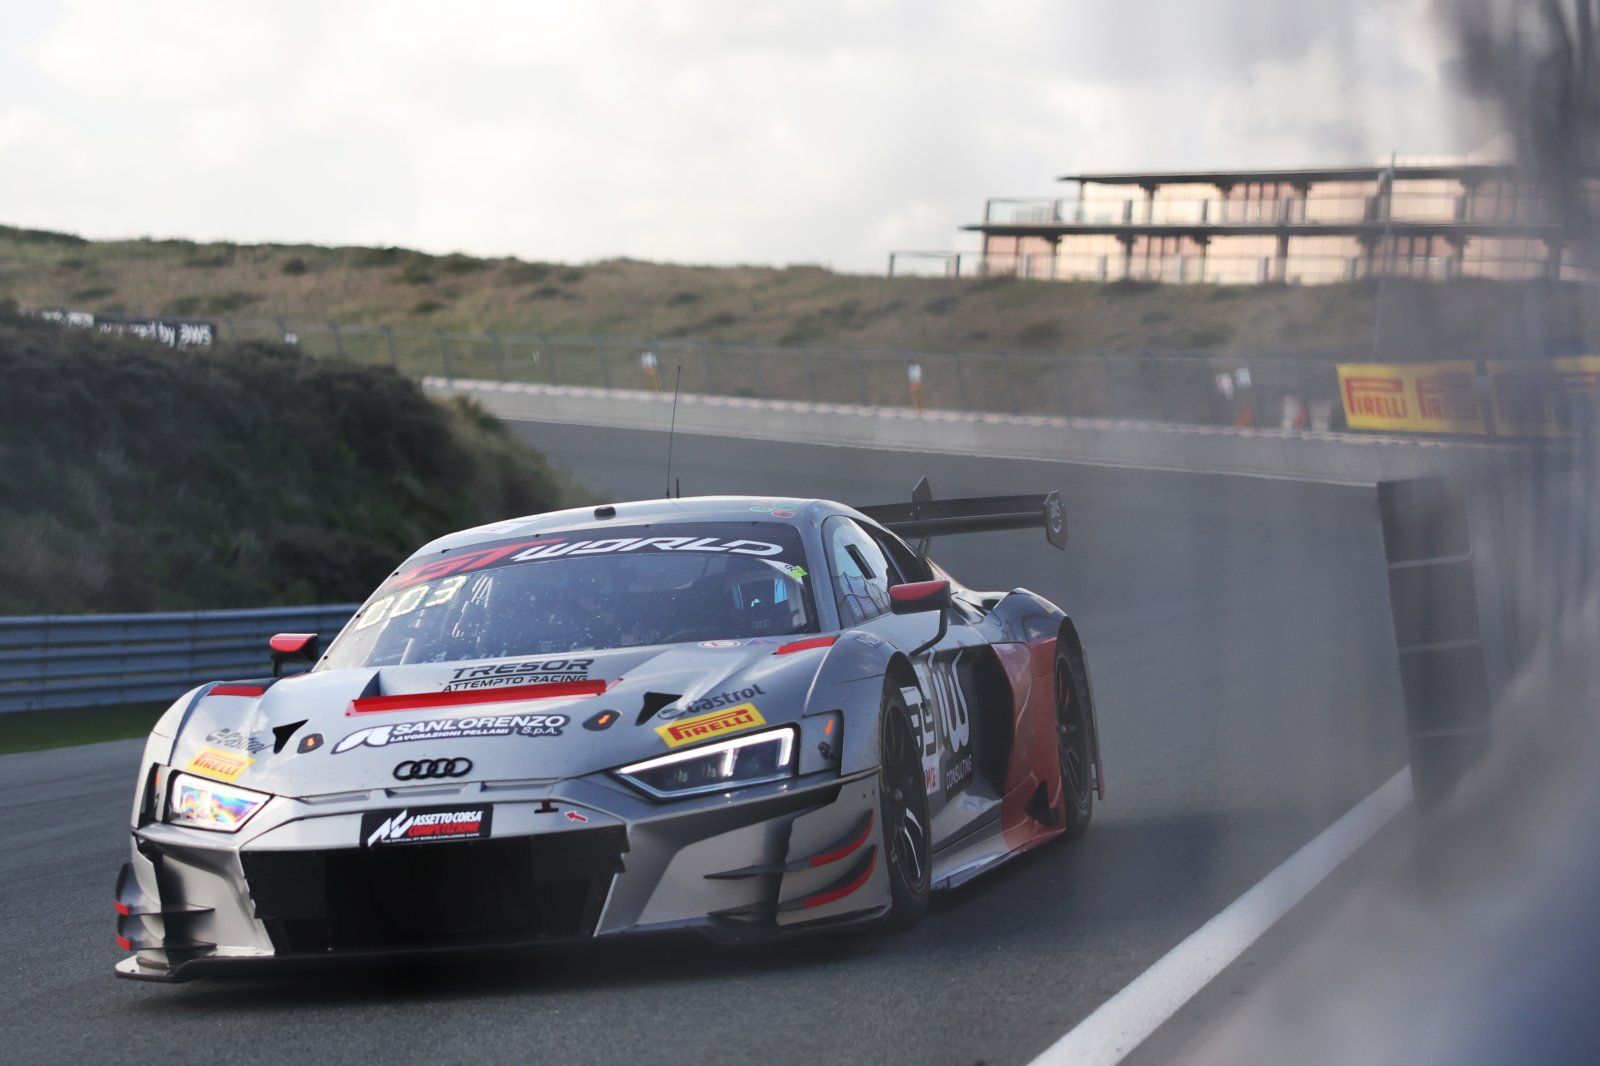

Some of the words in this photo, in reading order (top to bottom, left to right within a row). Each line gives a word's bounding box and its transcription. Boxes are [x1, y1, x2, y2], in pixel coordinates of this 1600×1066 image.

[1344, 377, 1408, 419] PIRELLI
[510, 537, 784, 562] WORLD
[453, 658, 595, 680] TRESOR
[442, 676, 524, 693] ATTEMPTO
[528, 674, 588, 684] RACING
[687, 683, 766, 714] Castrol
[390, 731, 461, 742] LAVORAZIONI
[463, 728, 509, 737] PELLAMI
[521, 726, 557, 736] S.p.A.
[394, 715, 565, 735] SANLORENZO
[667, 708, 755, 741] PIRELLI
[193, 752, 245, 776] PIRELLI
[413, 812, 454, 826] ASSETTO
[453, 810, 482, 822] CORSA
